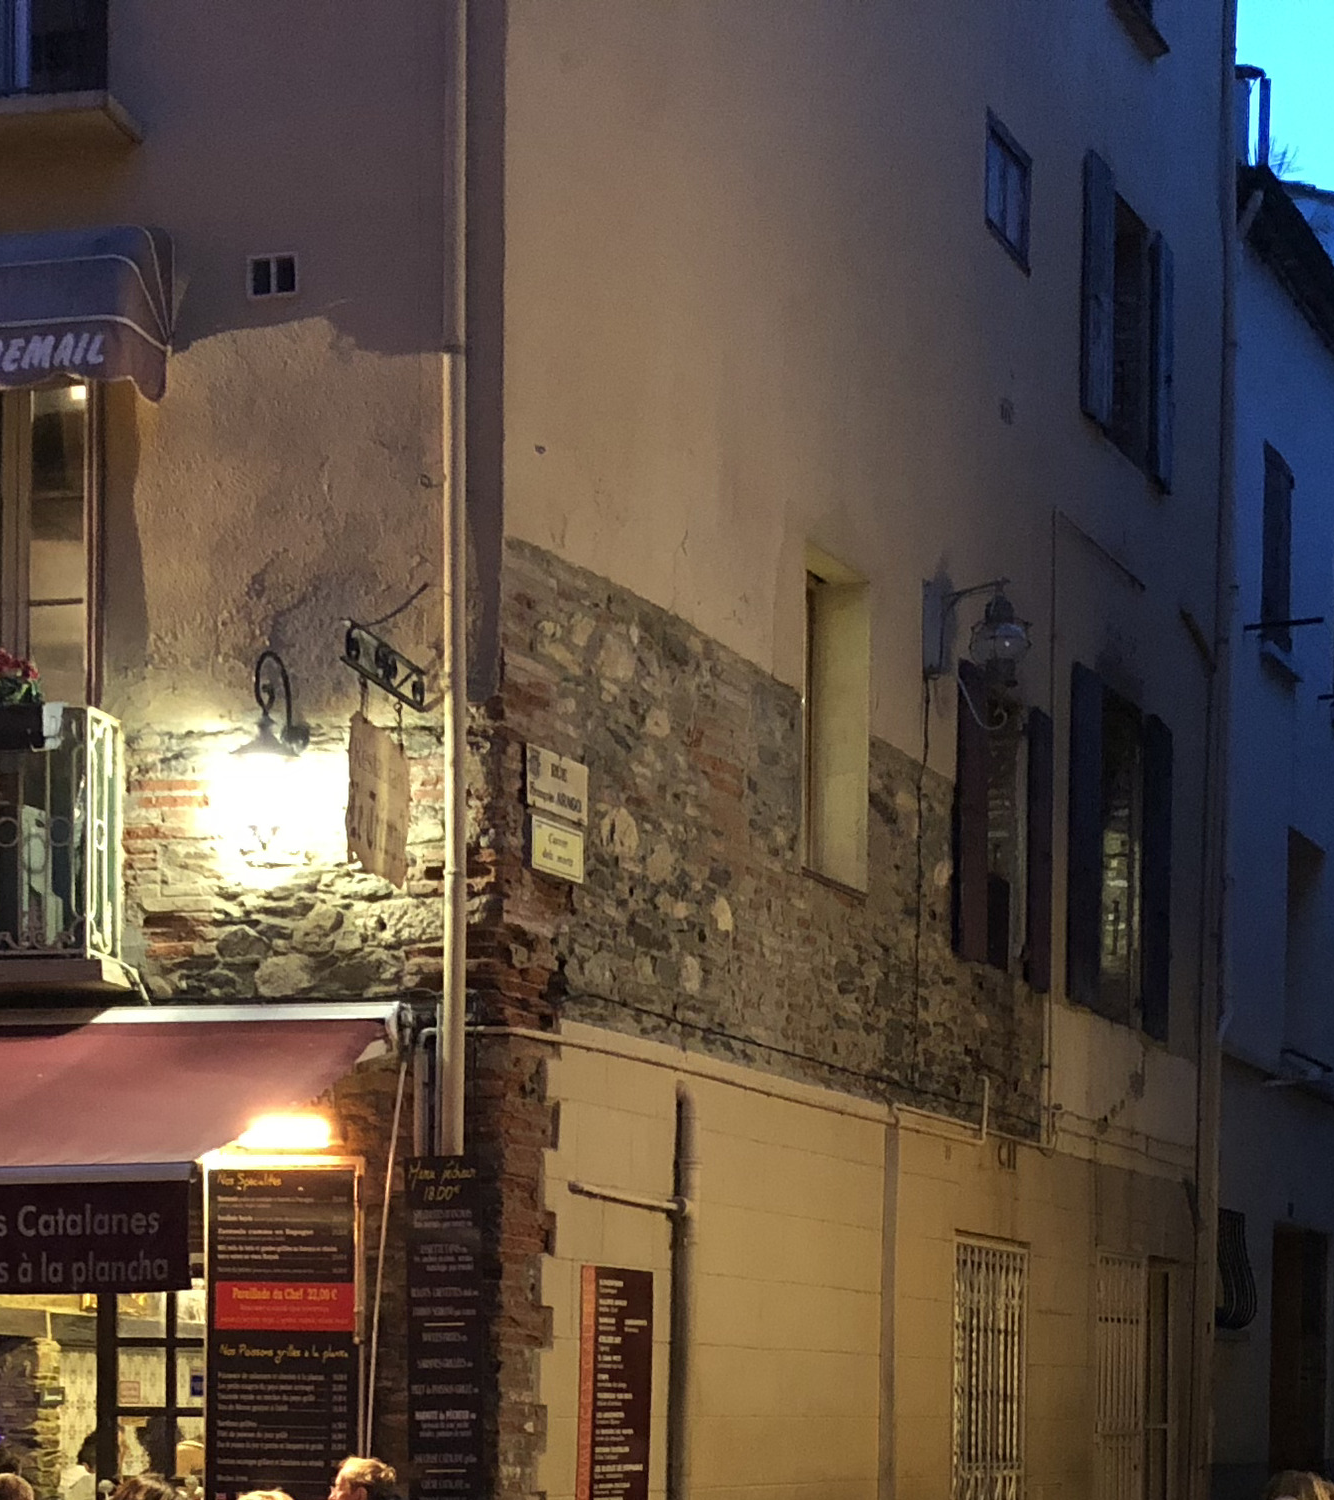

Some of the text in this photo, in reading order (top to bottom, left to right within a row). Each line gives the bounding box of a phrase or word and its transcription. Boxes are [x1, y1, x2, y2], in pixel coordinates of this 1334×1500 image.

[550, 763, 568, 783] RUE
[16, 1203, 161, 1238] Catalanes
[17, 1251, 33, 1283] à
[41, 1251, 64, 1283] la
[72, 1249, 169, 1290] plancha
